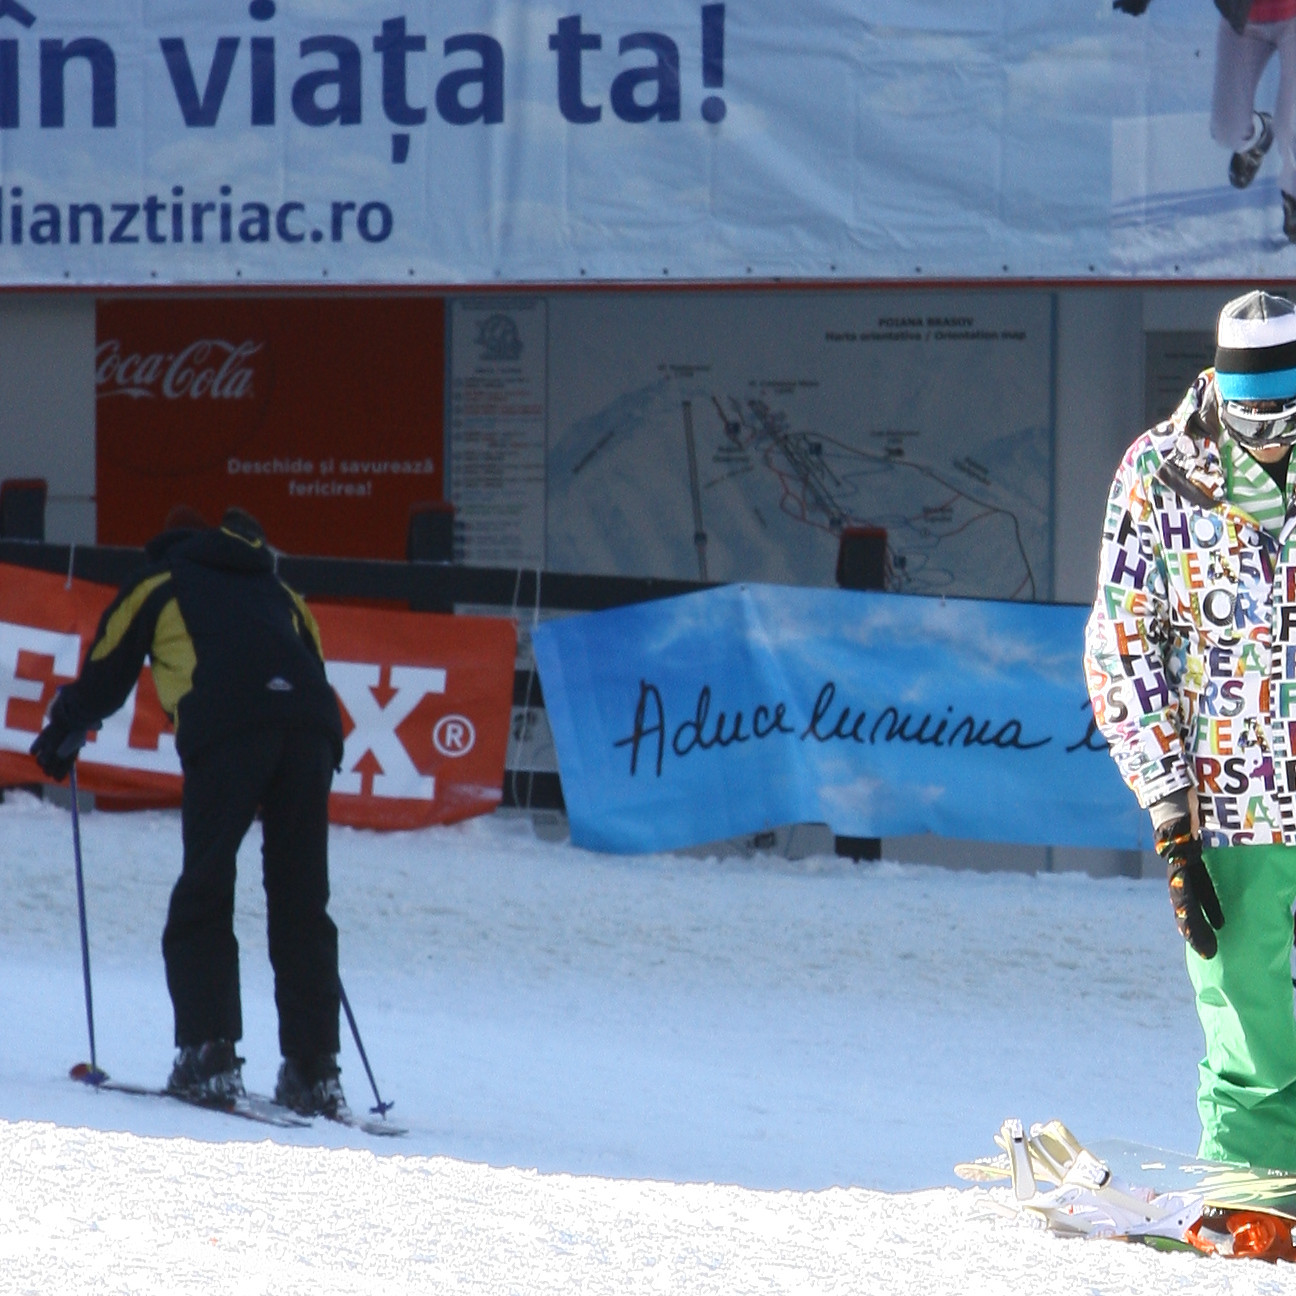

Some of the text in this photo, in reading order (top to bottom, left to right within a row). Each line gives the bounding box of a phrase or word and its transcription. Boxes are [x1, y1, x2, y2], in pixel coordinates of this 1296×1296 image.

[548, 3, 728, 125] ta!
[0, 184, 394, 245] ianztiriac.ro
[227, 458, 314, 475] Deschide
[288, 479, 373, 496] fericirea!
[614, 679, 796, 777] Aduce
